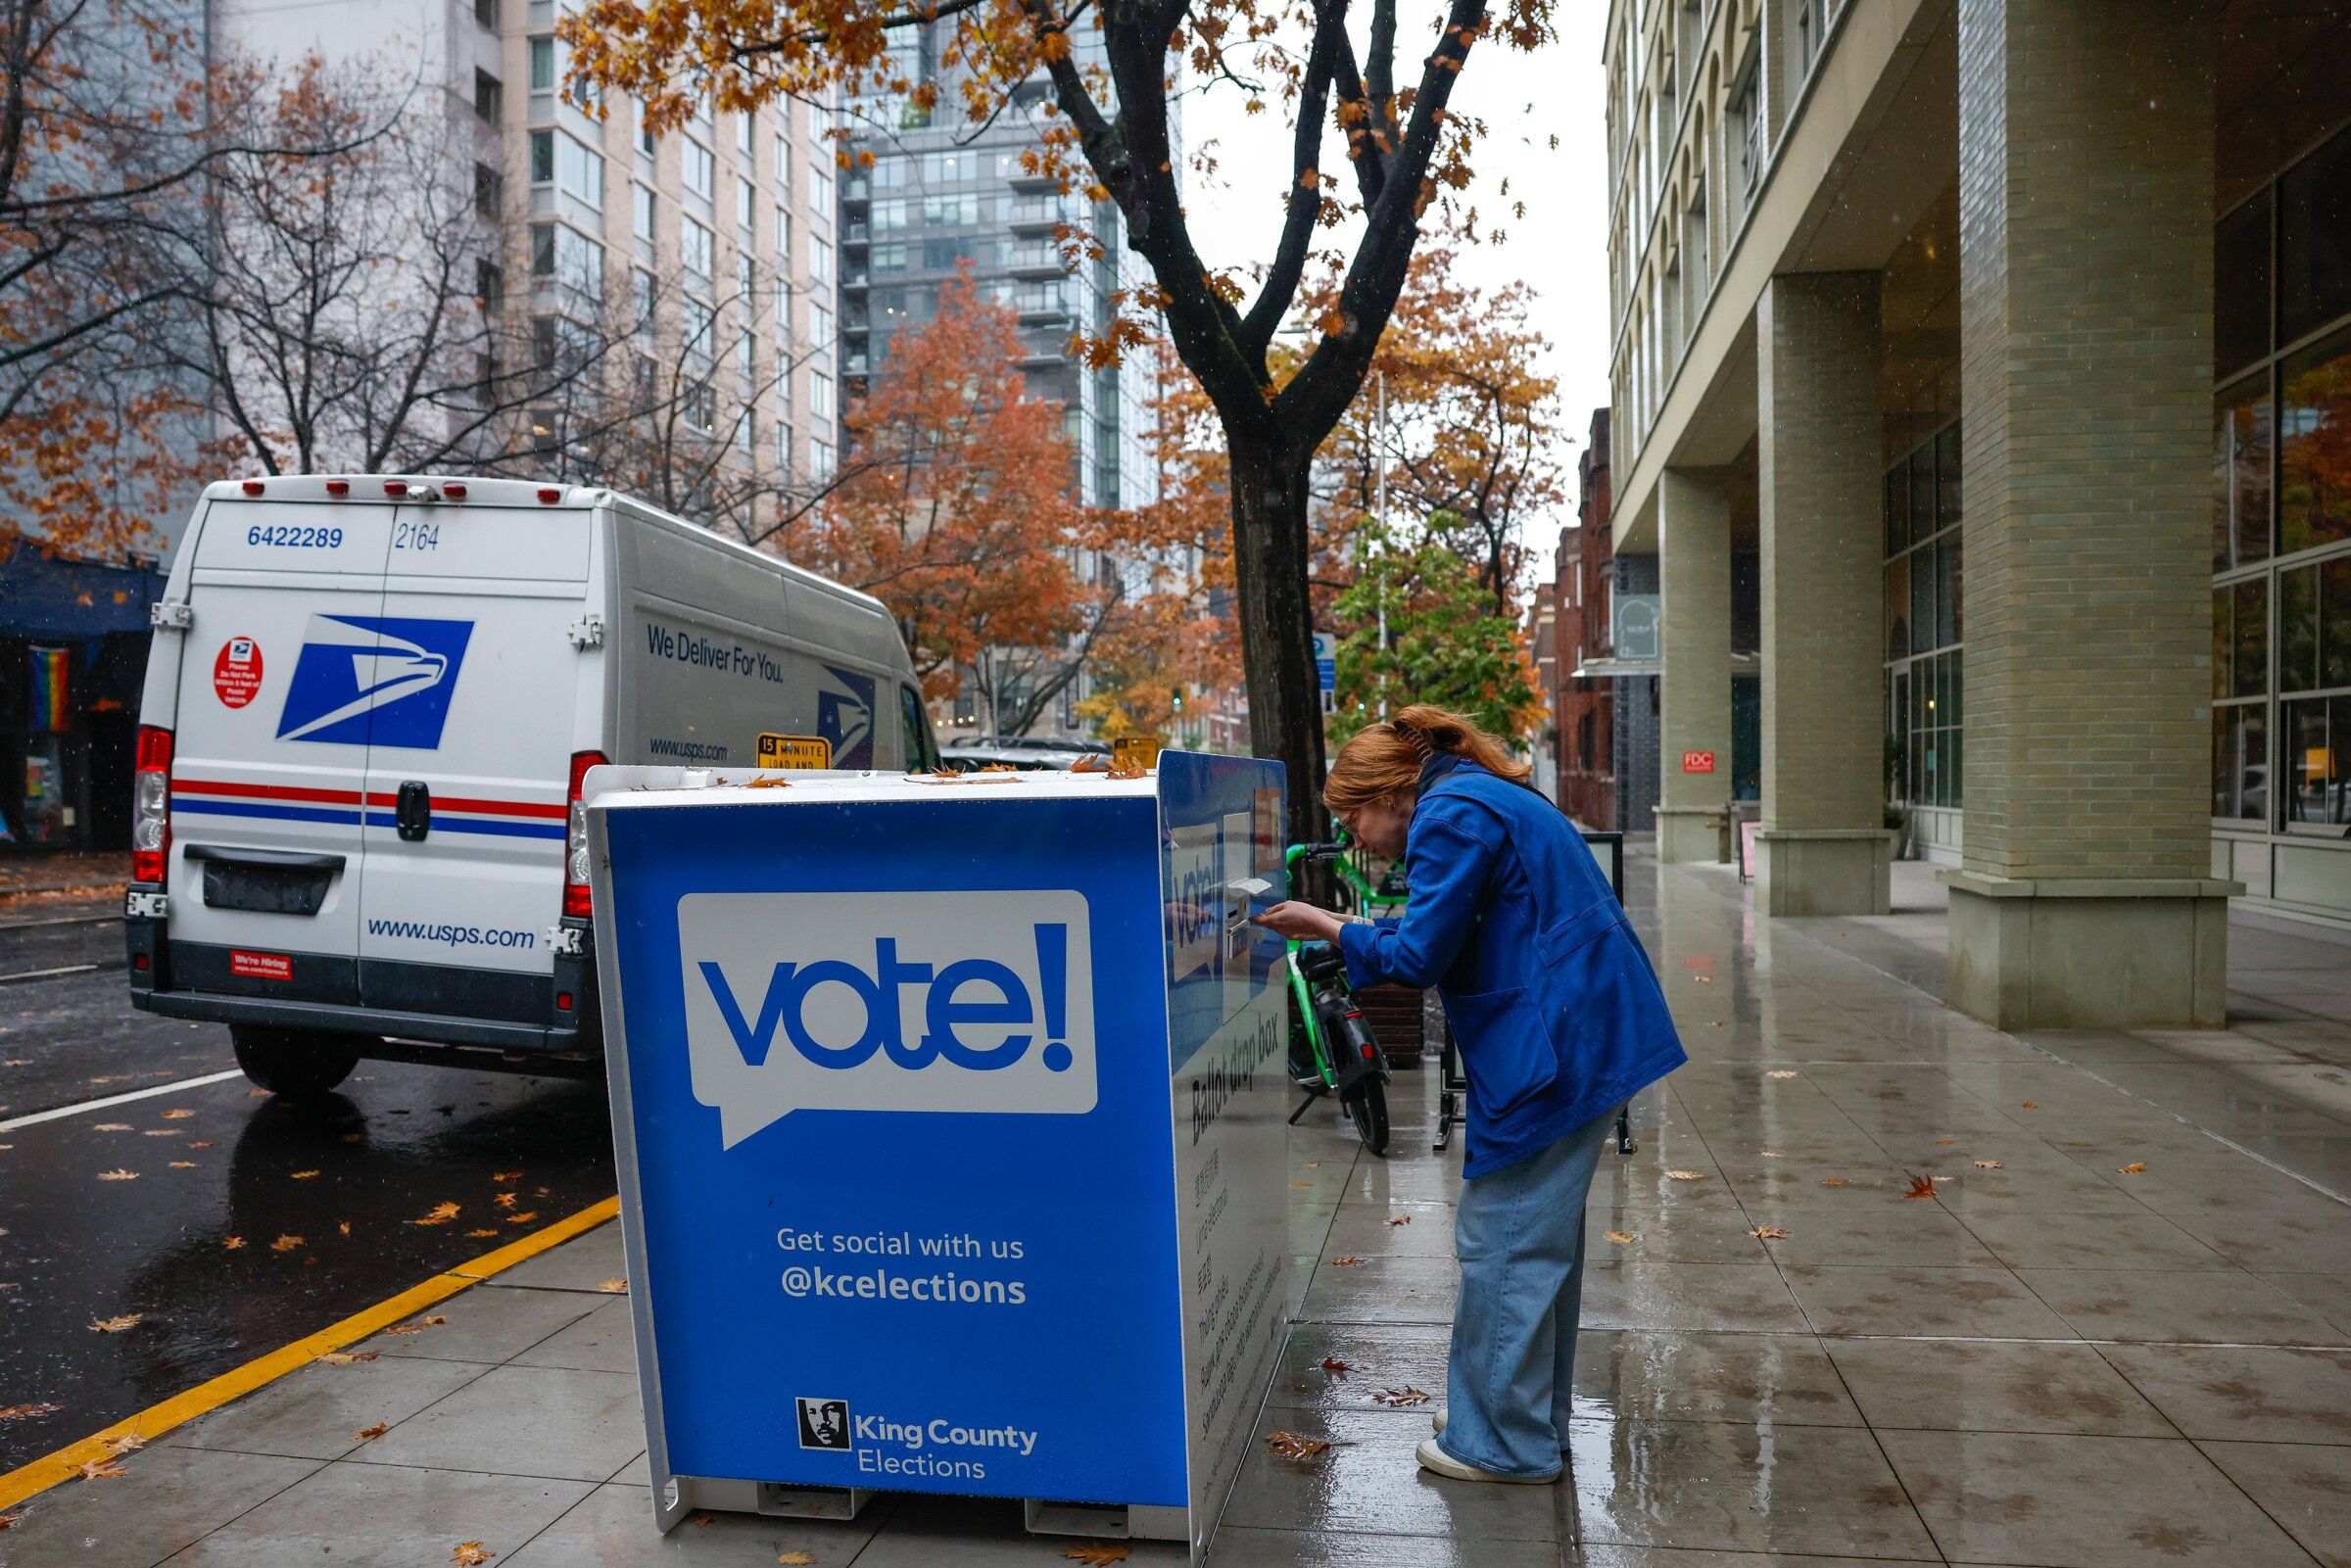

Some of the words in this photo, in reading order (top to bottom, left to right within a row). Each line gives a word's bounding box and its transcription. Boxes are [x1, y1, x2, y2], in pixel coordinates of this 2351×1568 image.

[247, 525, 343, 548] 6422289
[395, 522, 440, 550] 2164
[648, 624, 674, 659] We
[677, 632, 731, 671] Deliver
[733, 646, 755, 676] For
[757, 652, 784, 684] You.
[649, 737, 728, 762] www.usps.com
[763, 737, 774, 752] 15
[1175, 842, 1216, 948] vote!
[368, 919, 535, 949] www.usps.com
[234, 954, 260, 966] We're
[261, 957, 288, 970] Hiring
[697, 923, 1074, 1072] vote!
[1191, 1057, 1228, 1146] Ballot
[1228, 1030, 1256, 1093] drop
[1258, 1012, 1278, 1065] box
[777, 1226, 824, 1253] Get
[832, 1231, 910, 1256] social
[918, 1233, 982, 1259] with
[991, 1240, 1025, 1259] us
[781, 1265, 1027, 1305] @kcelections
[855, 1414, 923, 1449] King
[928, 1419, 1038, 1456] County
[857, 1449, 986, 1480] Elections
